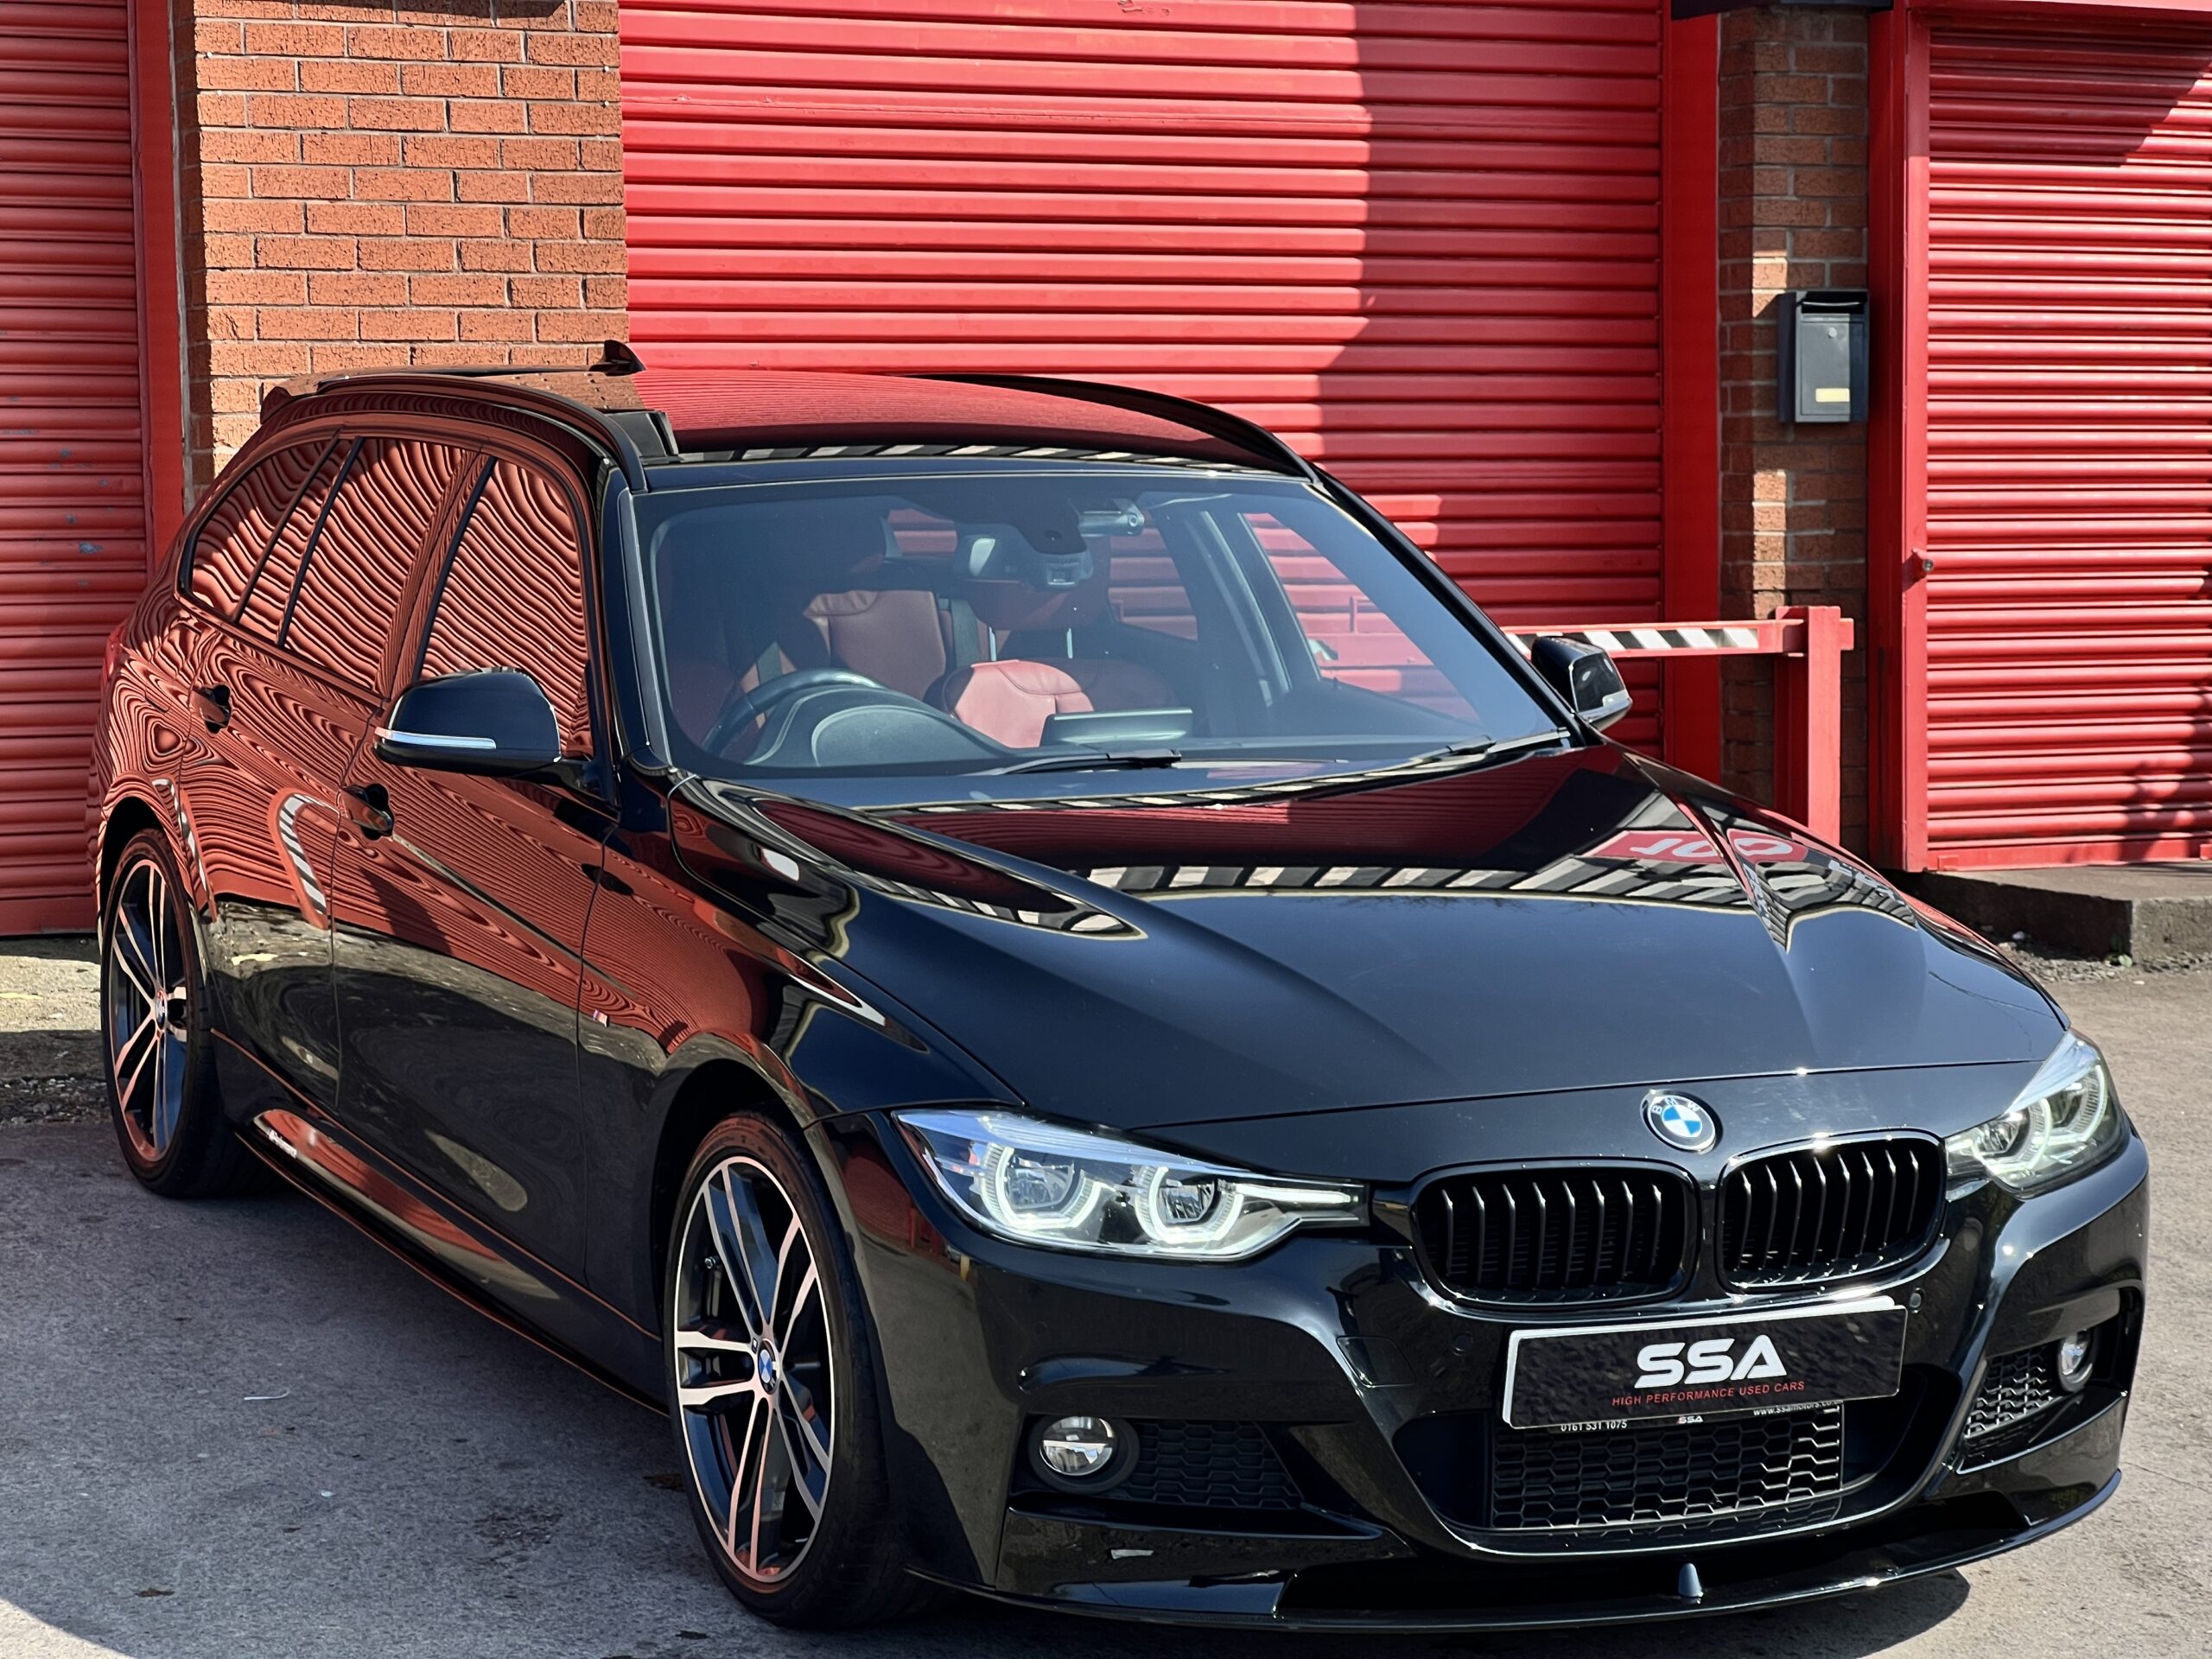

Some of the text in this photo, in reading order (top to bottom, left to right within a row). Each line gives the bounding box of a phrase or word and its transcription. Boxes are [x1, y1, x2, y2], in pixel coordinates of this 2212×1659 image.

[1652, 1097, 1700, 1116] BMW
[1634, 1334, 1787, 1389] SSA
[1612, 1381, 1805, 1406] HIGH PERFORMANCE USED CARS
[1560, 1423, 1582, 1432] 0161
[1605, 1420, 1627, 1429] 1075
[1676, 1414, 1703, 1424] SSA
